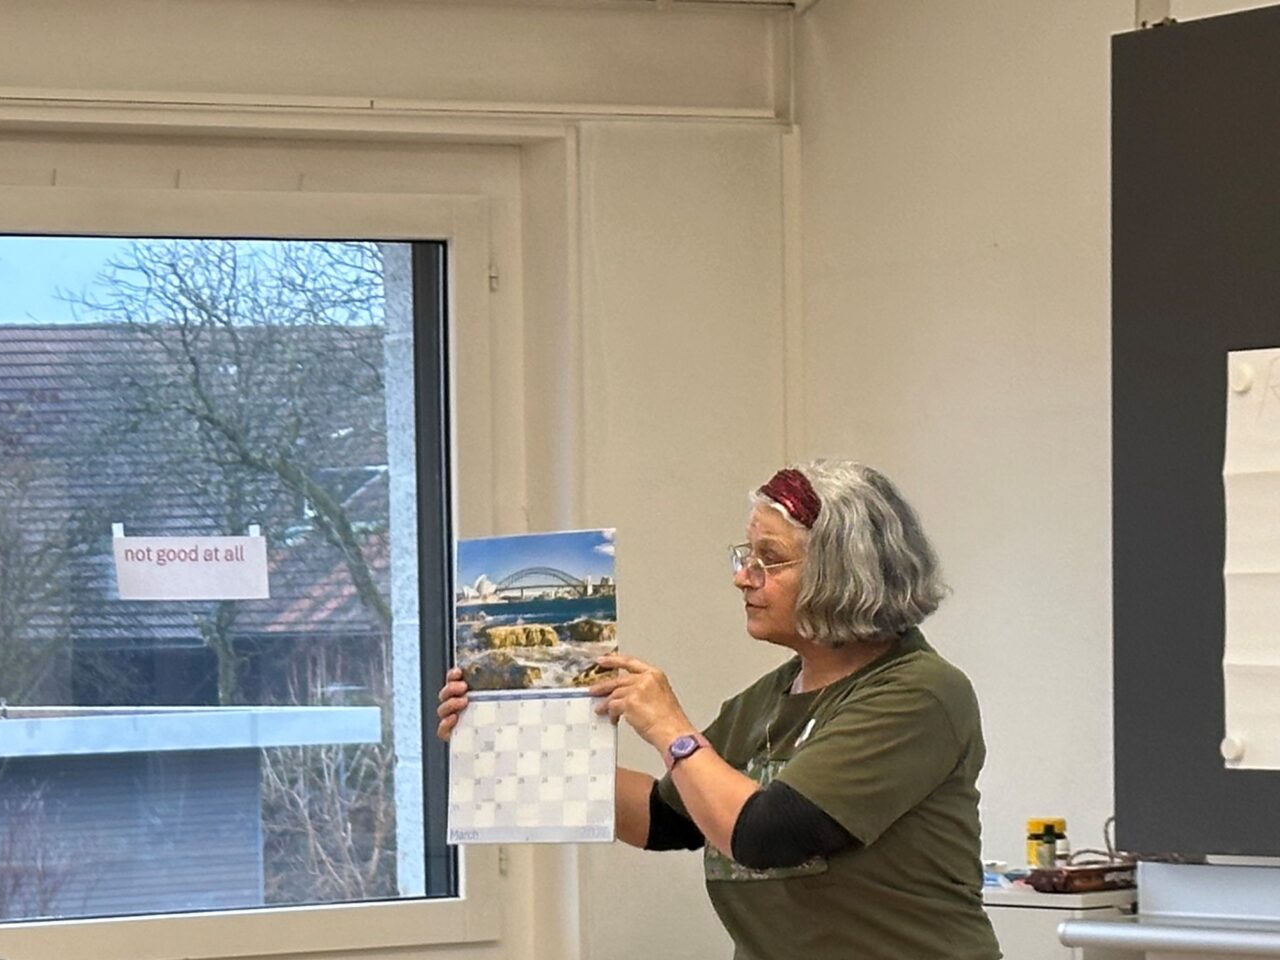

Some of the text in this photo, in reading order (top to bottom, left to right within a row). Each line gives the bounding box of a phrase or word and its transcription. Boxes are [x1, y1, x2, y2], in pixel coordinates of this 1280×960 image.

[124, 544, 245, 566] not good at all
